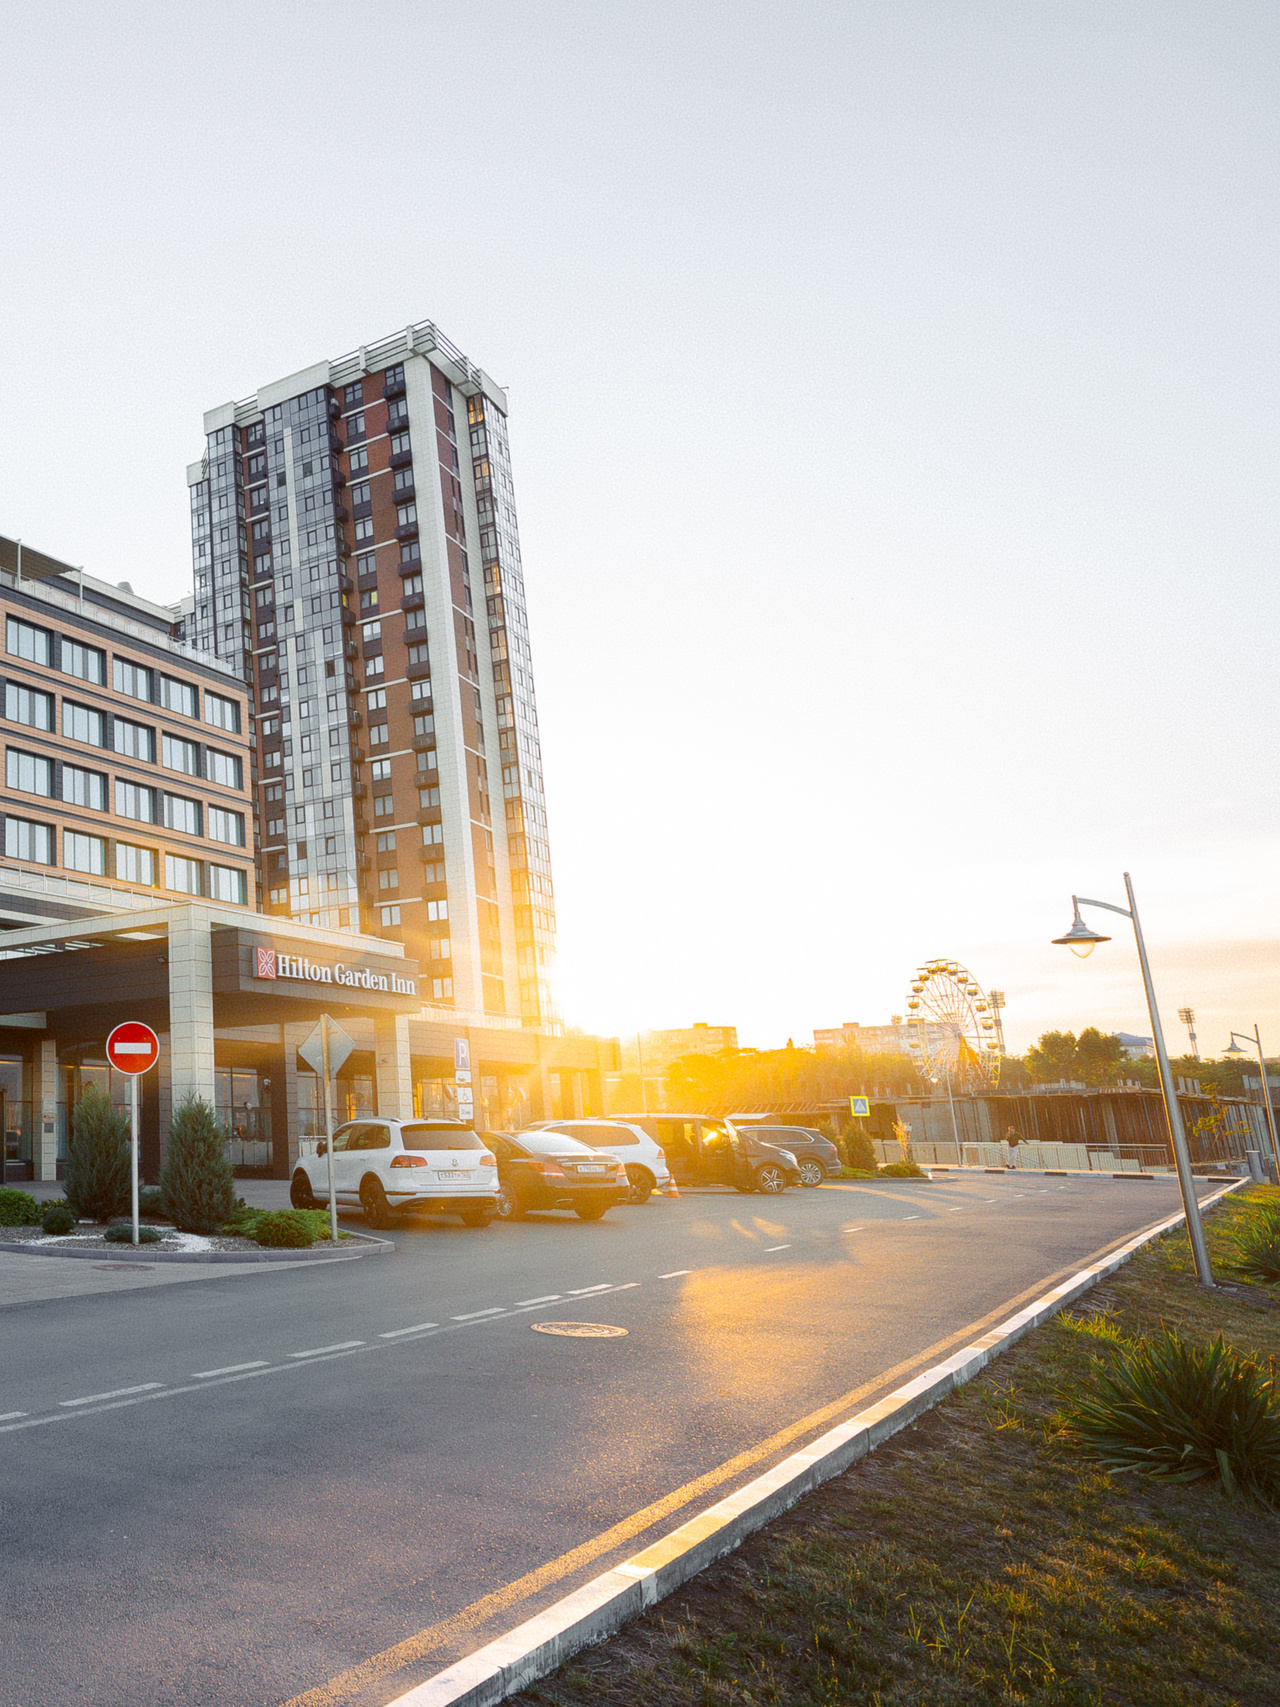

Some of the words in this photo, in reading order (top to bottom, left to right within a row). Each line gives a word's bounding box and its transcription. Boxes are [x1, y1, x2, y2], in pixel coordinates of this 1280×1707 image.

[276, 954, 333, 983] Hilton
[334, 963, 389, 991] Garden
[391, 972, 417, 996] Inn
[459, 1042, 468, 1066] P
